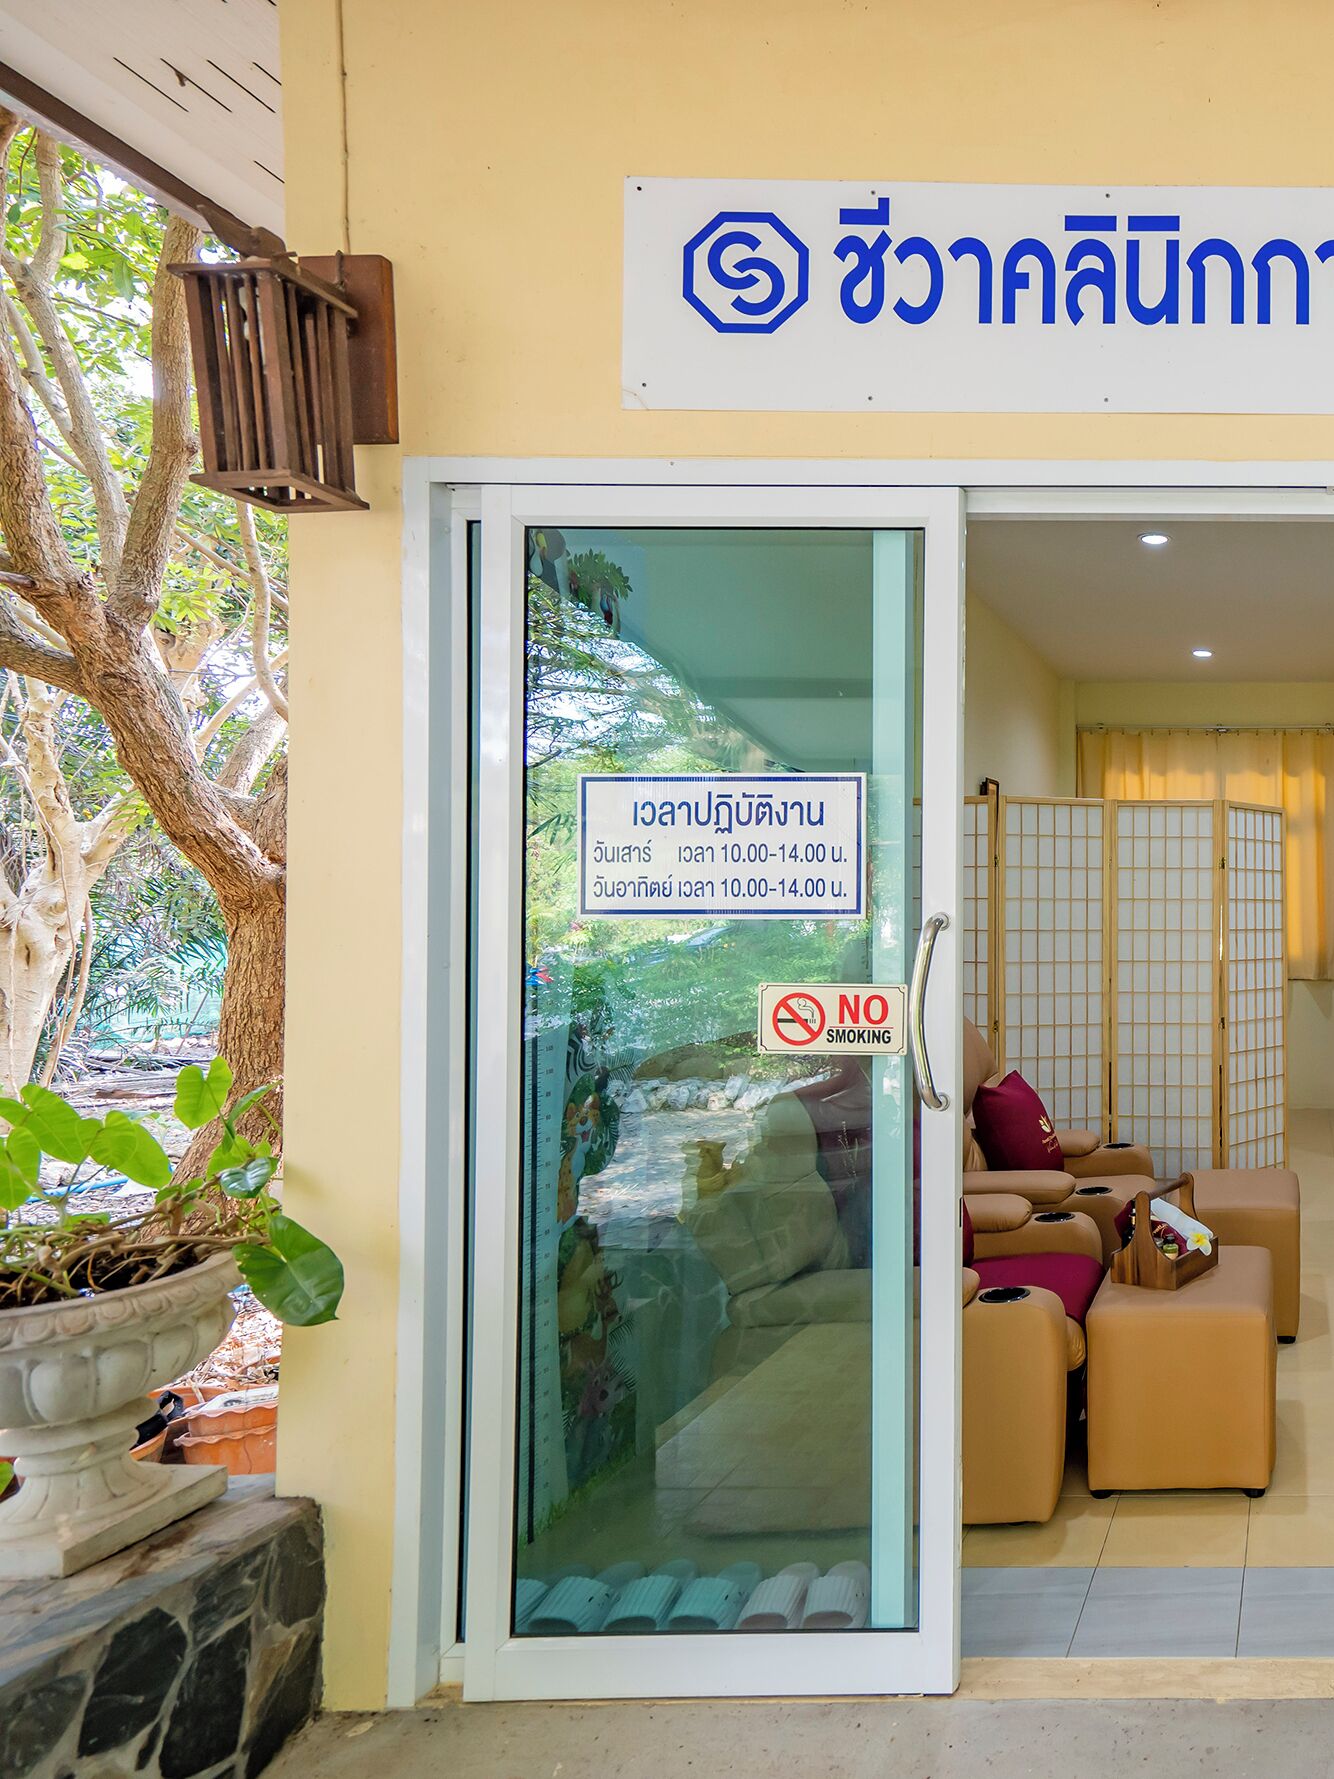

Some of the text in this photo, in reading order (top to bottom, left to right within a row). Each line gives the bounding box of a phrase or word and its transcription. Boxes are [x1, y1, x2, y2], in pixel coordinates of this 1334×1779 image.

[633, 791, 824, 834] เวลาปฏิบัติงาน
[593, 839, 848, 863] วันเสาร์ เวลา 10.00-14.00 น.
[593, 874, 848, 898] วันอาทิตย์ เวลา 10.00-14.00 น.
[838, 994, 889, 1025] NO
[826, 1029, 891, 1044] SMOKING
